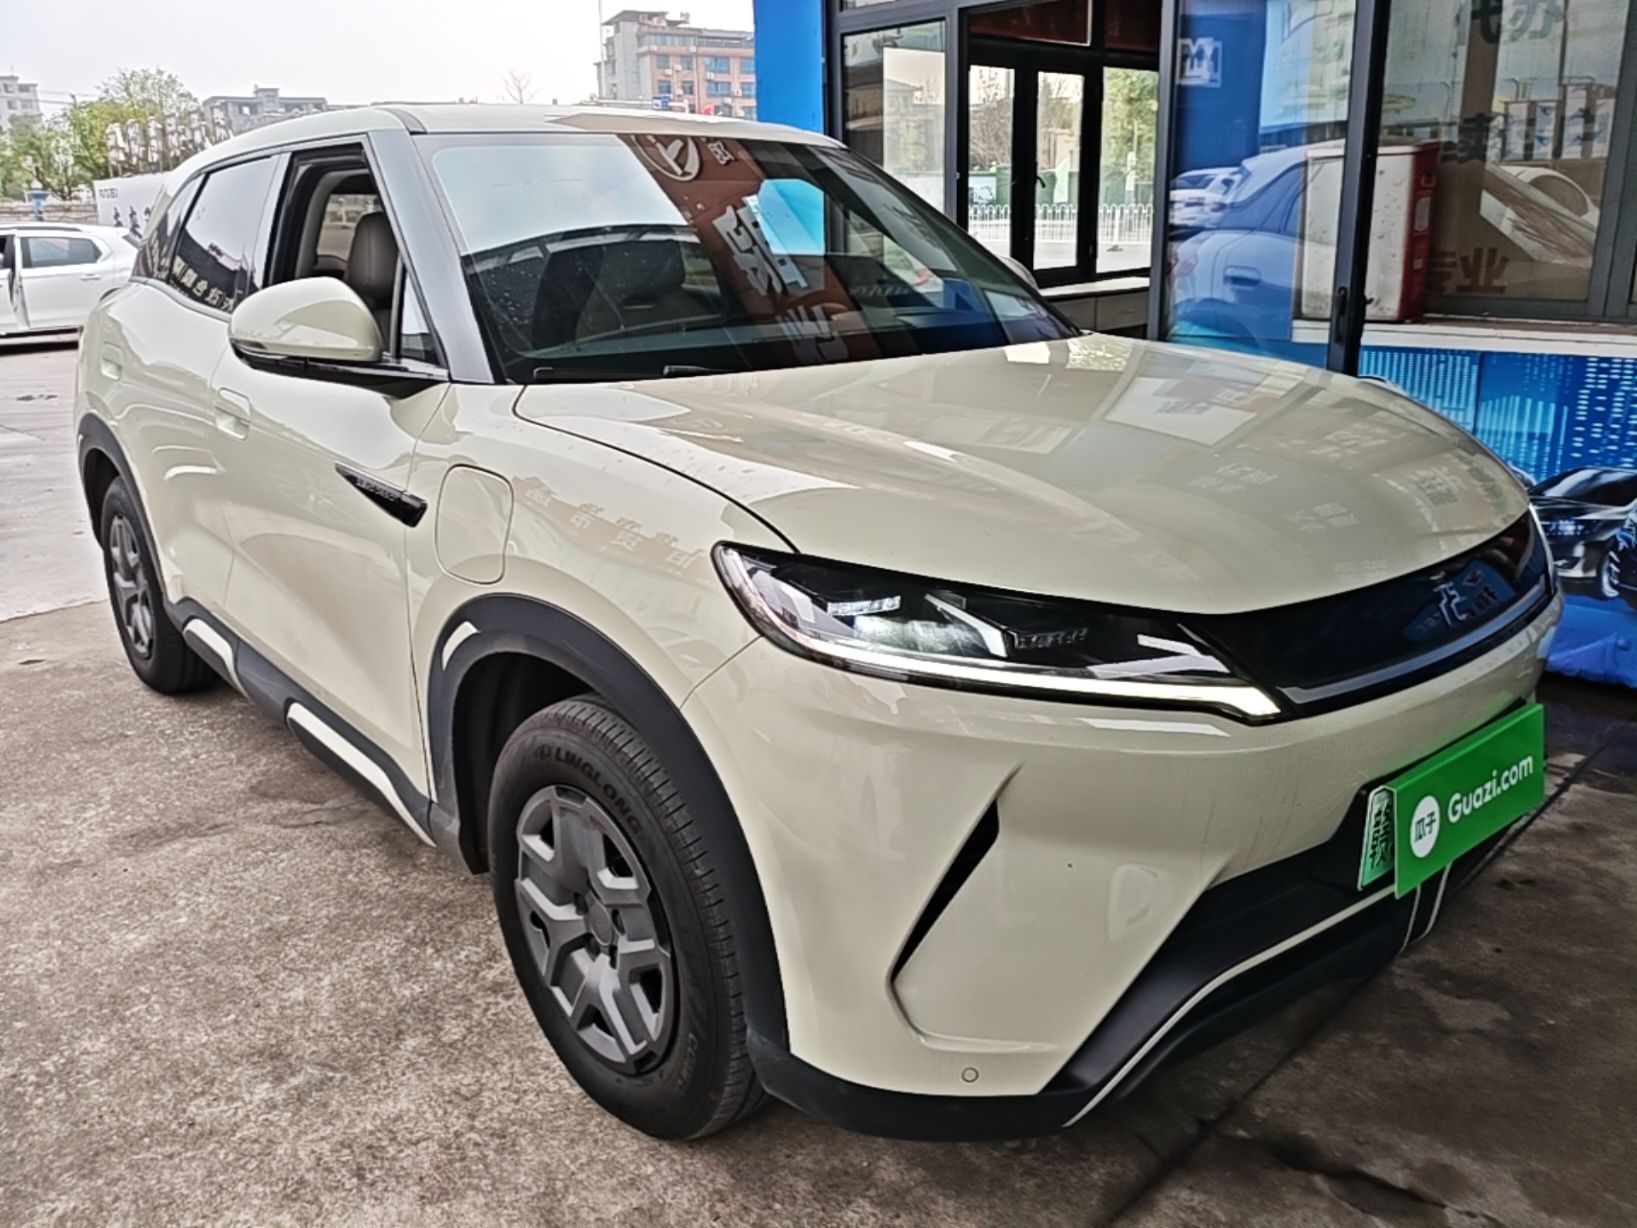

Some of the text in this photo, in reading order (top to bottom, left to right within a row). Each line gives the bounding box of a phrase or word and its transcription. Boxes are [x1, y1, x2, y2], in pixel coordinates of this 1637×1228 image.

[555, 747, 641, 834] LINGLONG
[1414, 811, 1437, 842] 瓜子
[1447, 755, 1534, 824] Guazi.com
